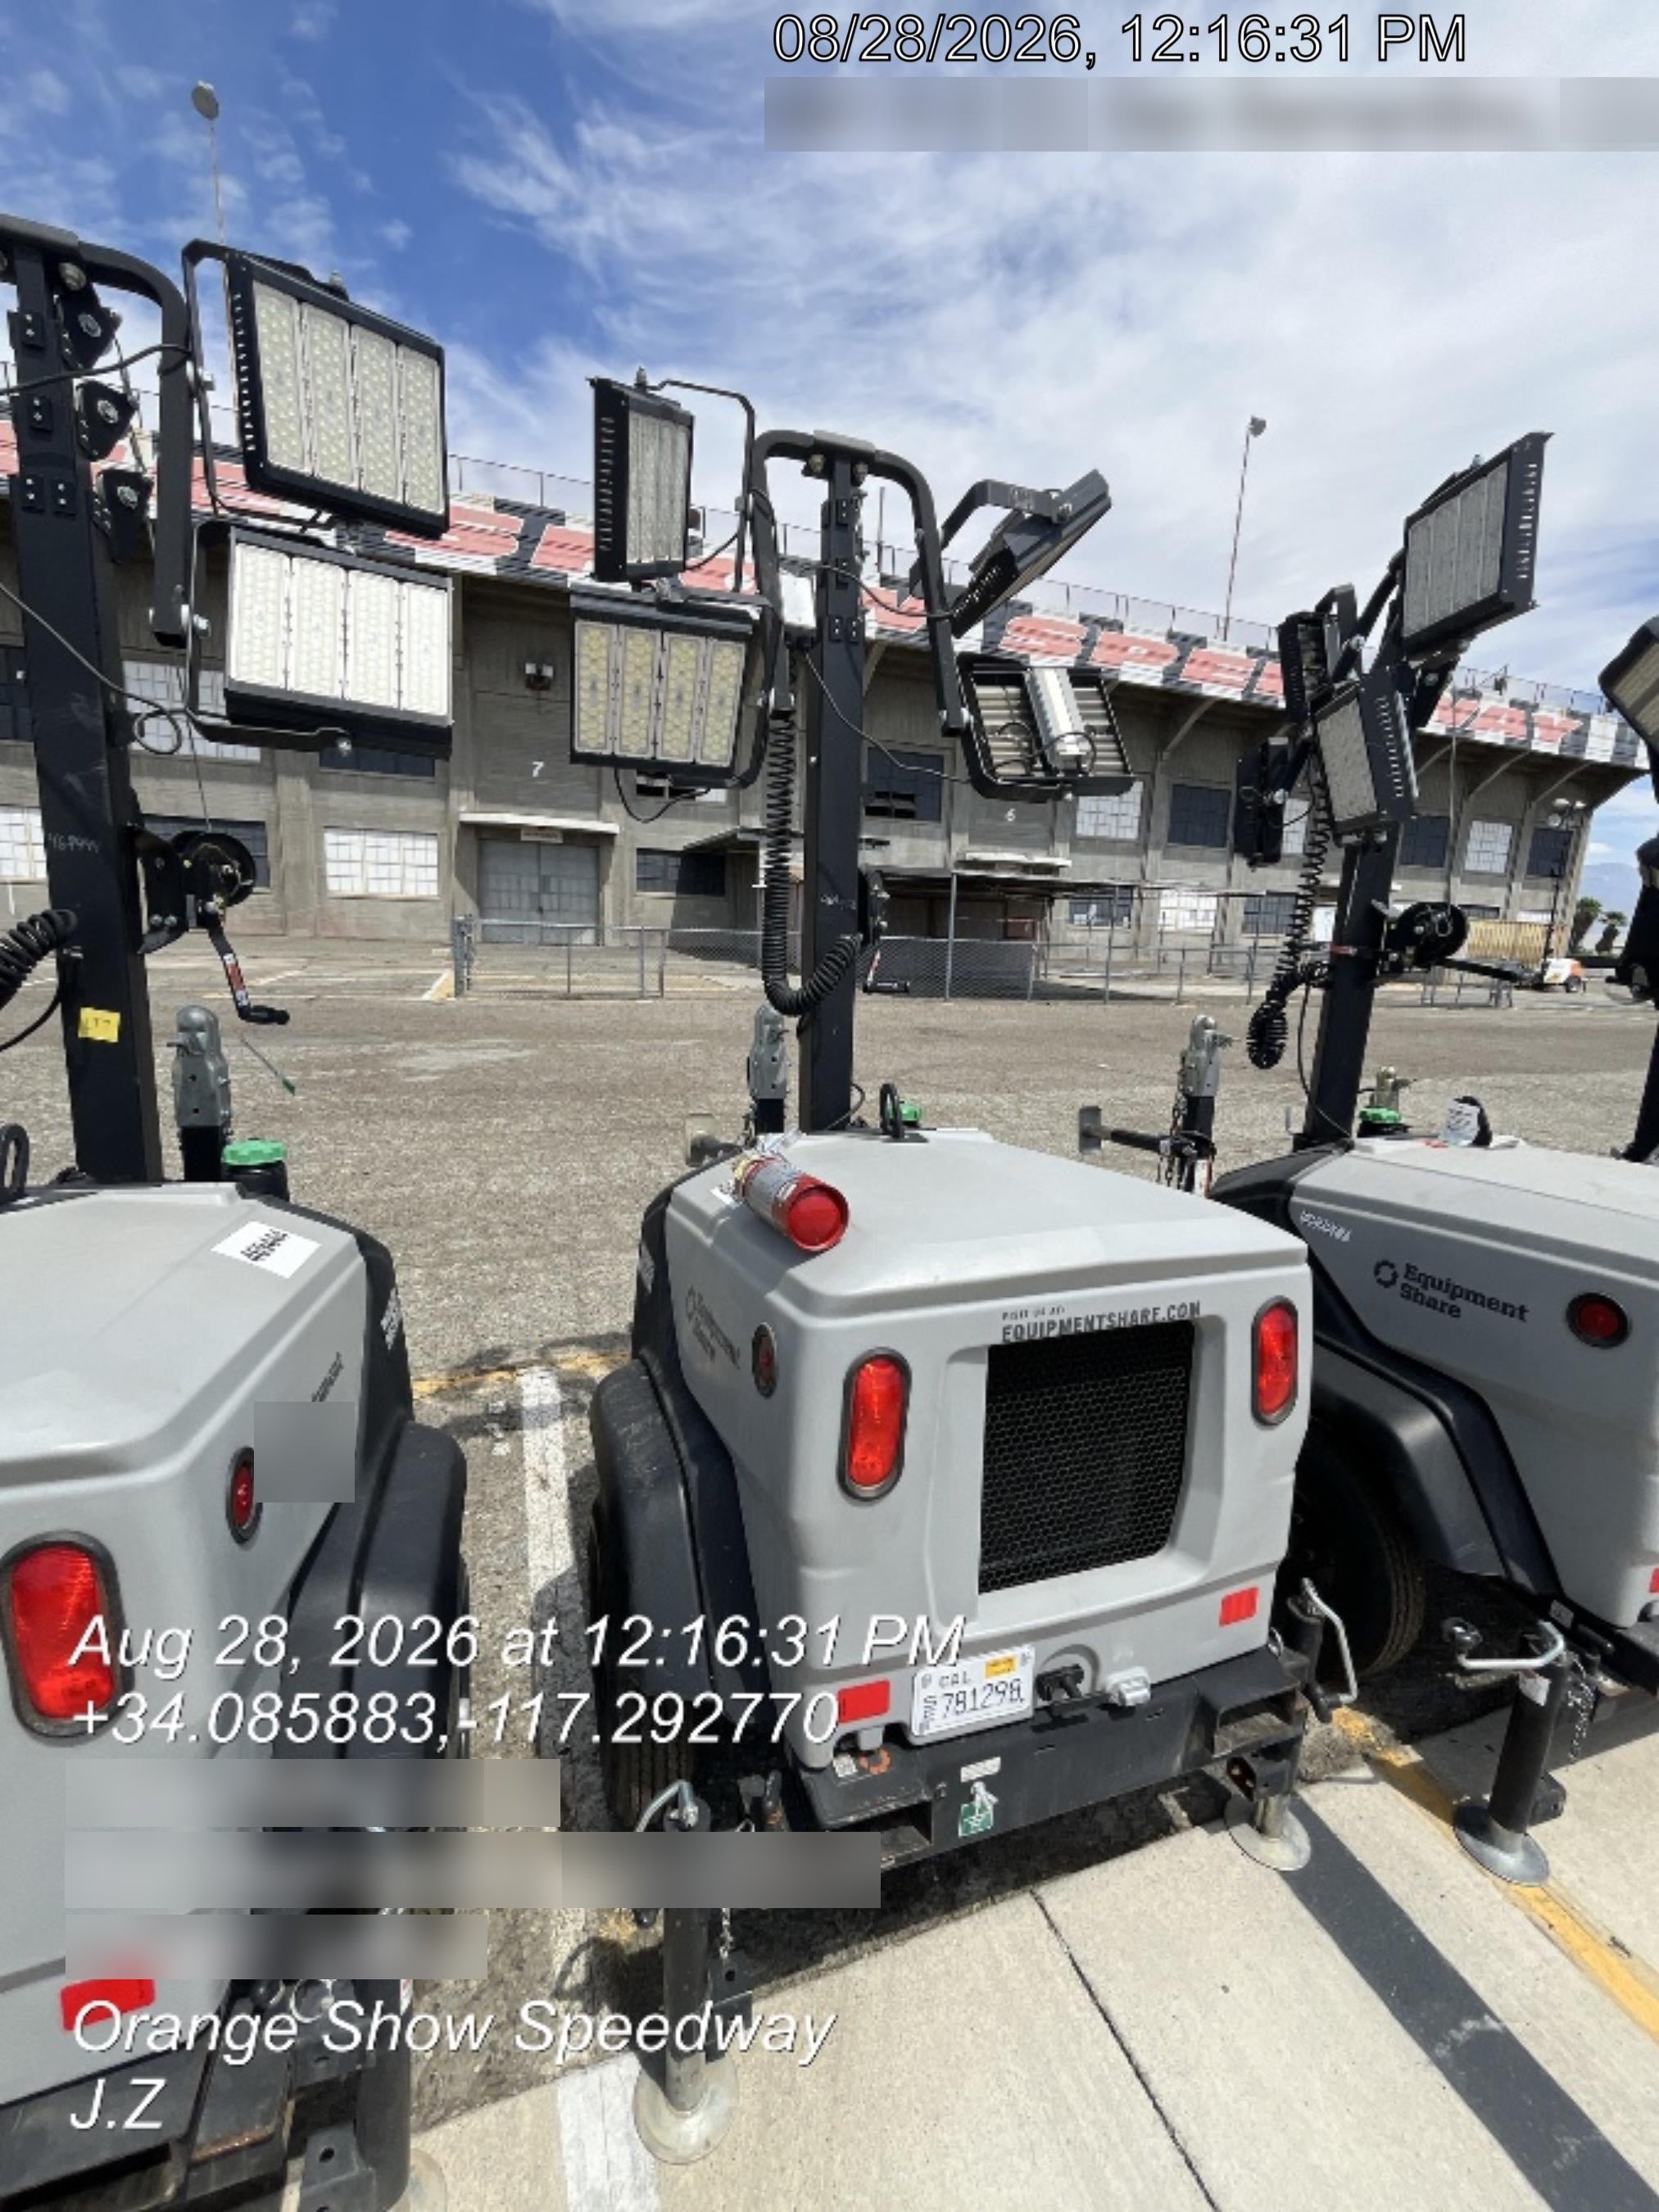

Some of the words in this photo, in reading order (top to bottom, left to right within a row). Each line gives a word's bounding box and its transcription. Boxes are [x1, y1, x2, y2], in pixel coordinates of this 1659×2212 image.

[532, 760, 544, 777] 7
[1400, 1282, 1461, 1318] Share
[1403, 1262, 1529, 1323] Equipment
[1002, 1300, 1201, 1343] EQUIPMENTSHARE.COM
[942, 1678, 1022, 1719] 781298
